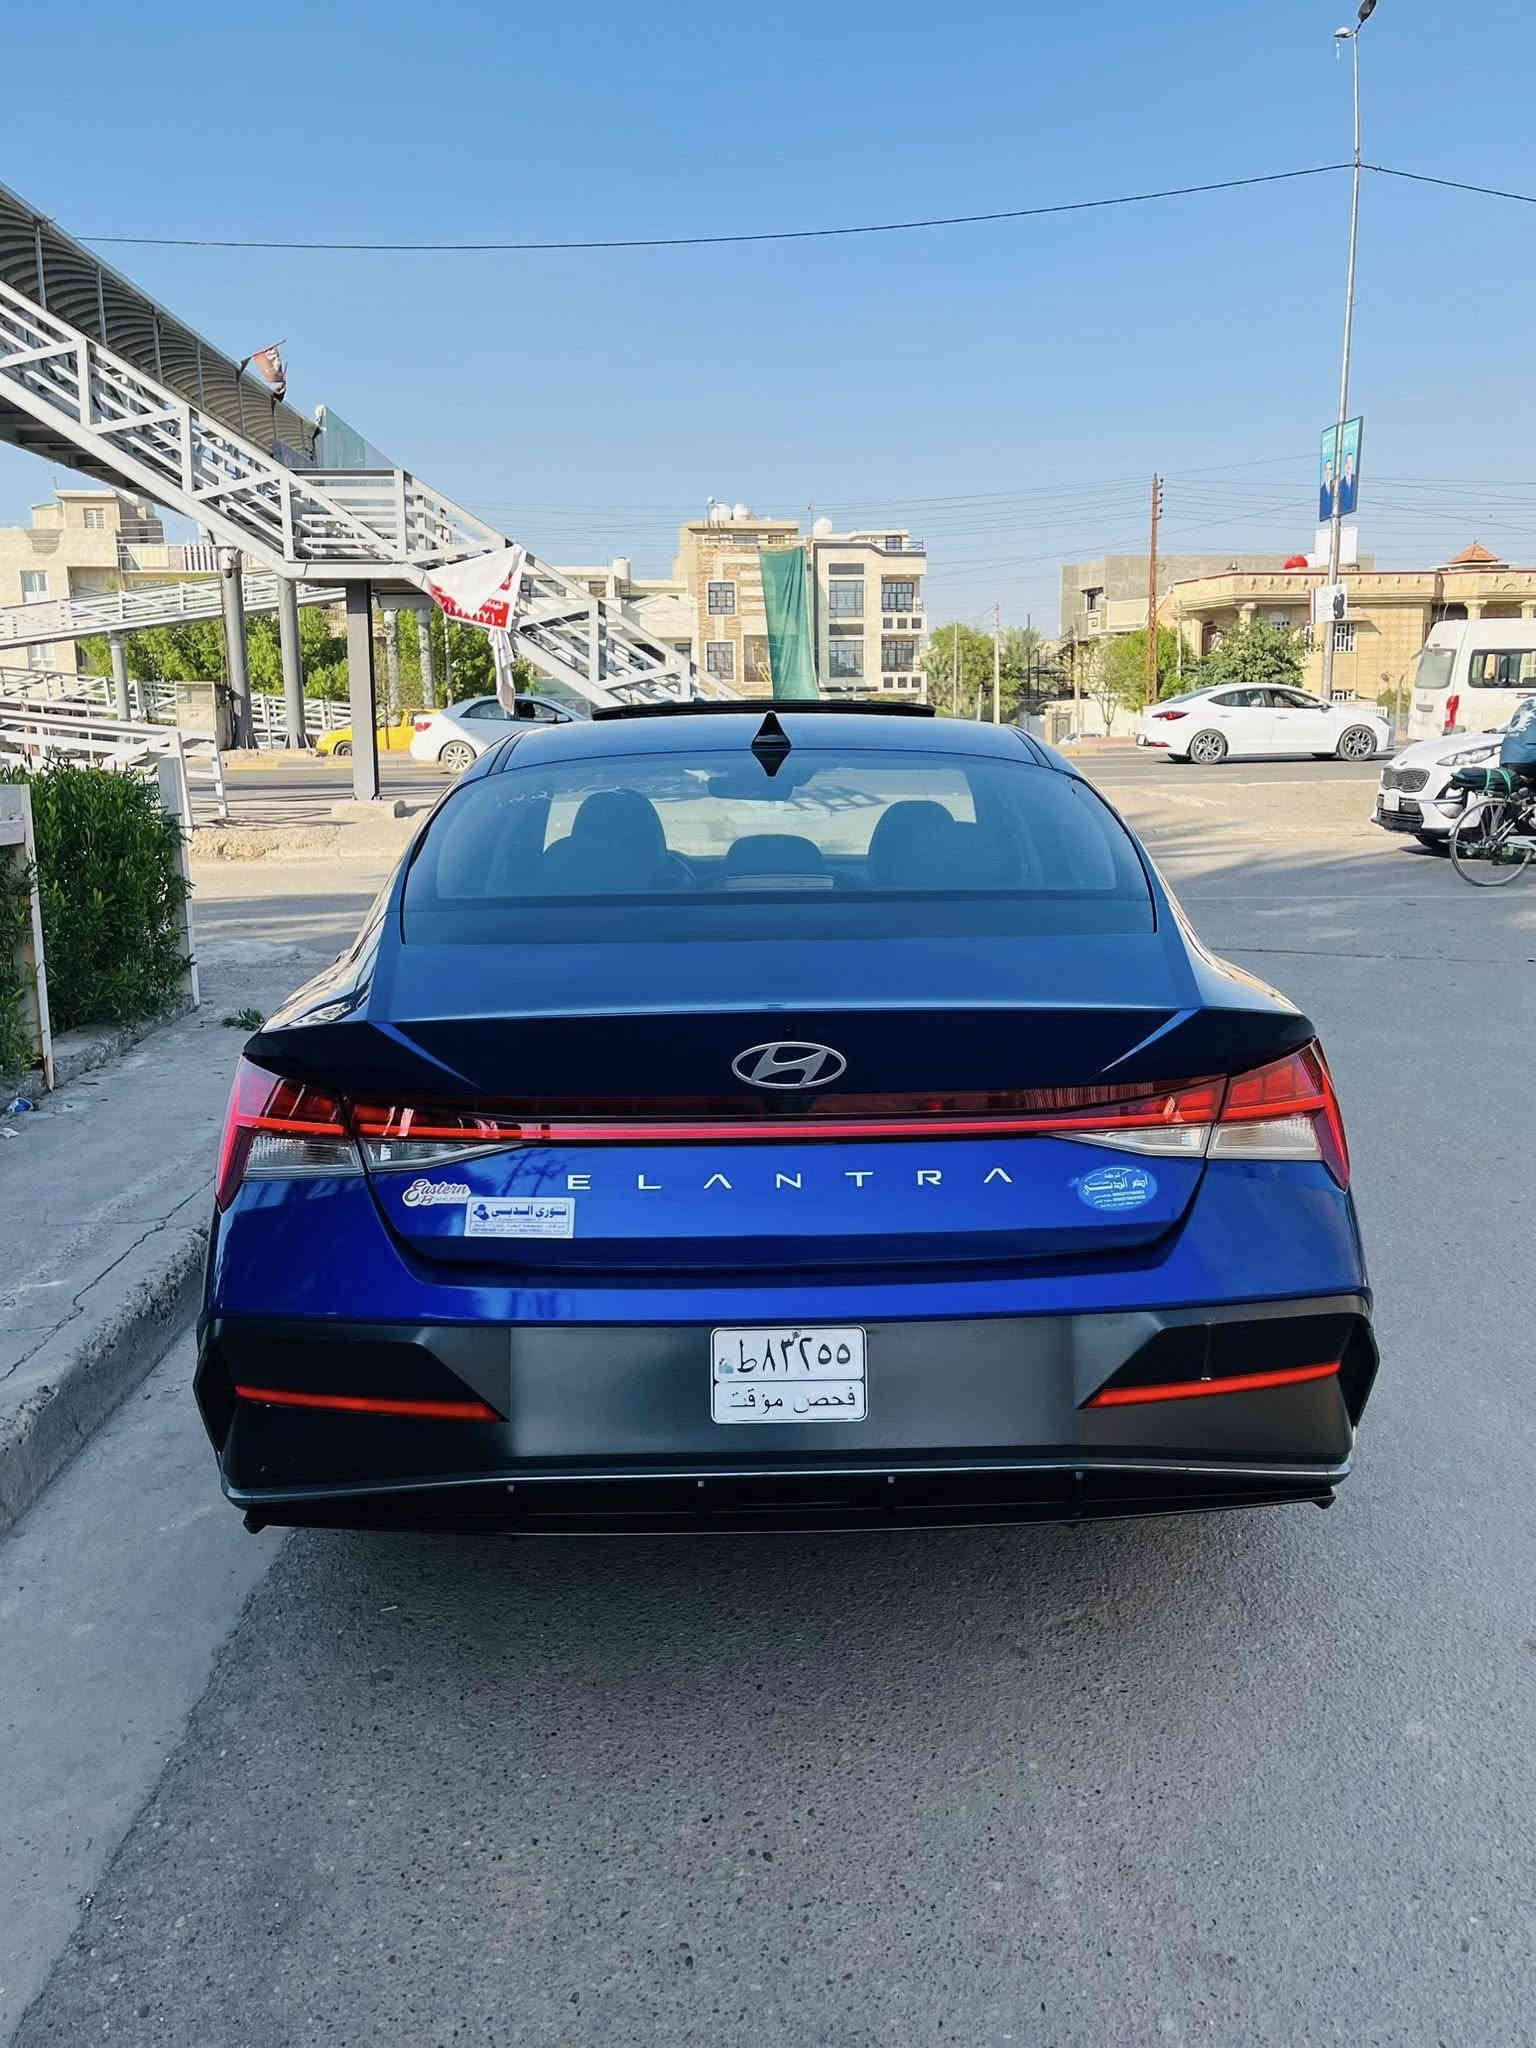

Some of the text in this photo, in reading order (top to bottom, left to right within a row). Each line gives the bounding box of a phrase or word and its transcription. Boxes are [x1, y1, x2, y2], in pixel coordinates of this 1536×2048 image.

[567, 1168, 1012, 1190] ELANTRA
[404, 1180, 467, 1201] Eastern
[793, 1386, 856, 1414] فحص
